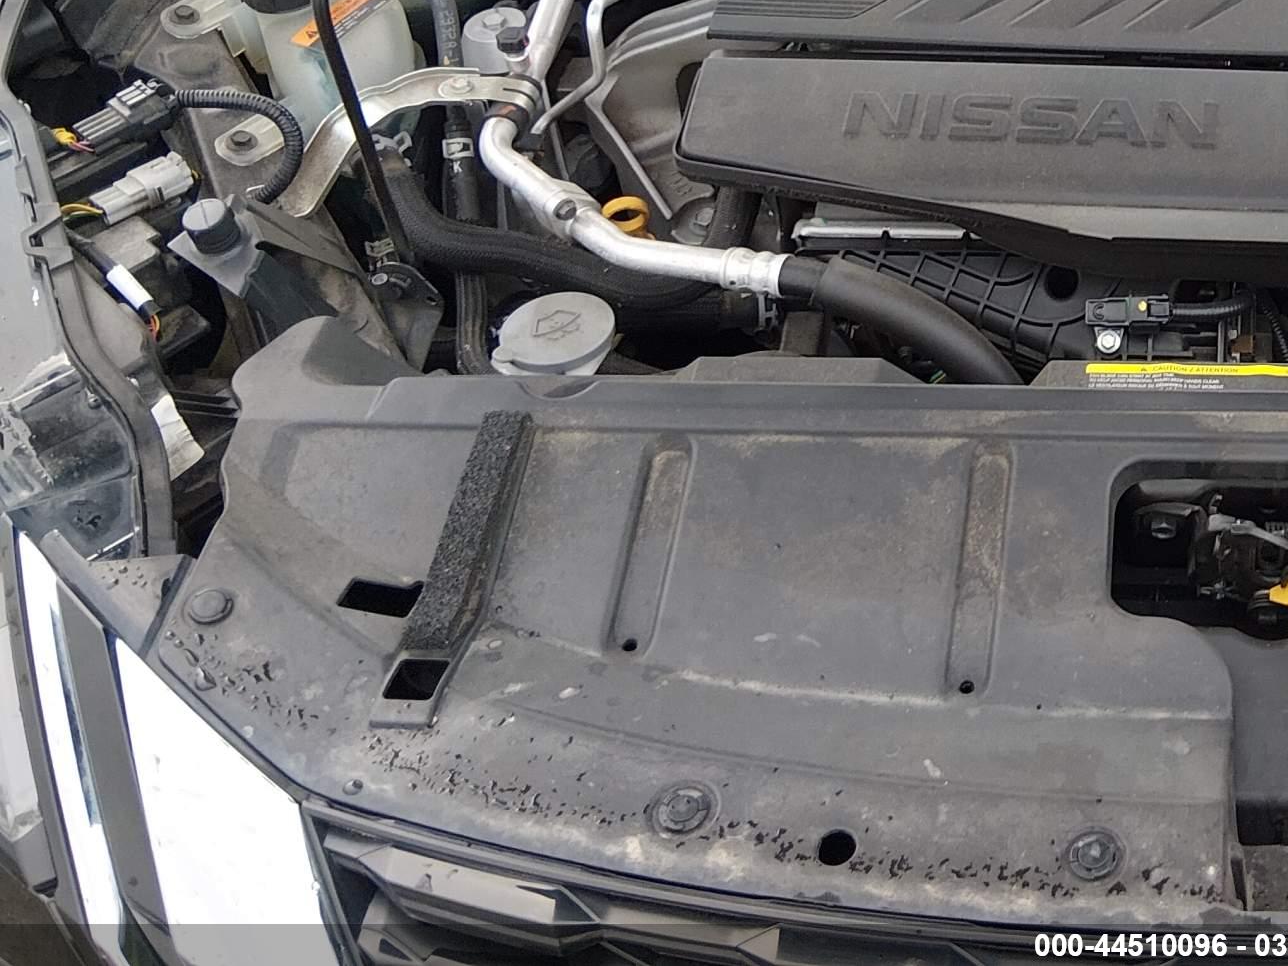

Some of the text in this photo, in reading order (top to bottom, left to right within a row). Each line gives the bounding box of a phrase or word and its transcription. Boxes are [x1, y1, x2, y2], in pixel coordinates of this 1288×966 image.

[842, 89, 1220, 150] NISSAN
[1152, 365, 1188, 373] CAUTION
[1195, 366, 1239, 374] ATTENTION
